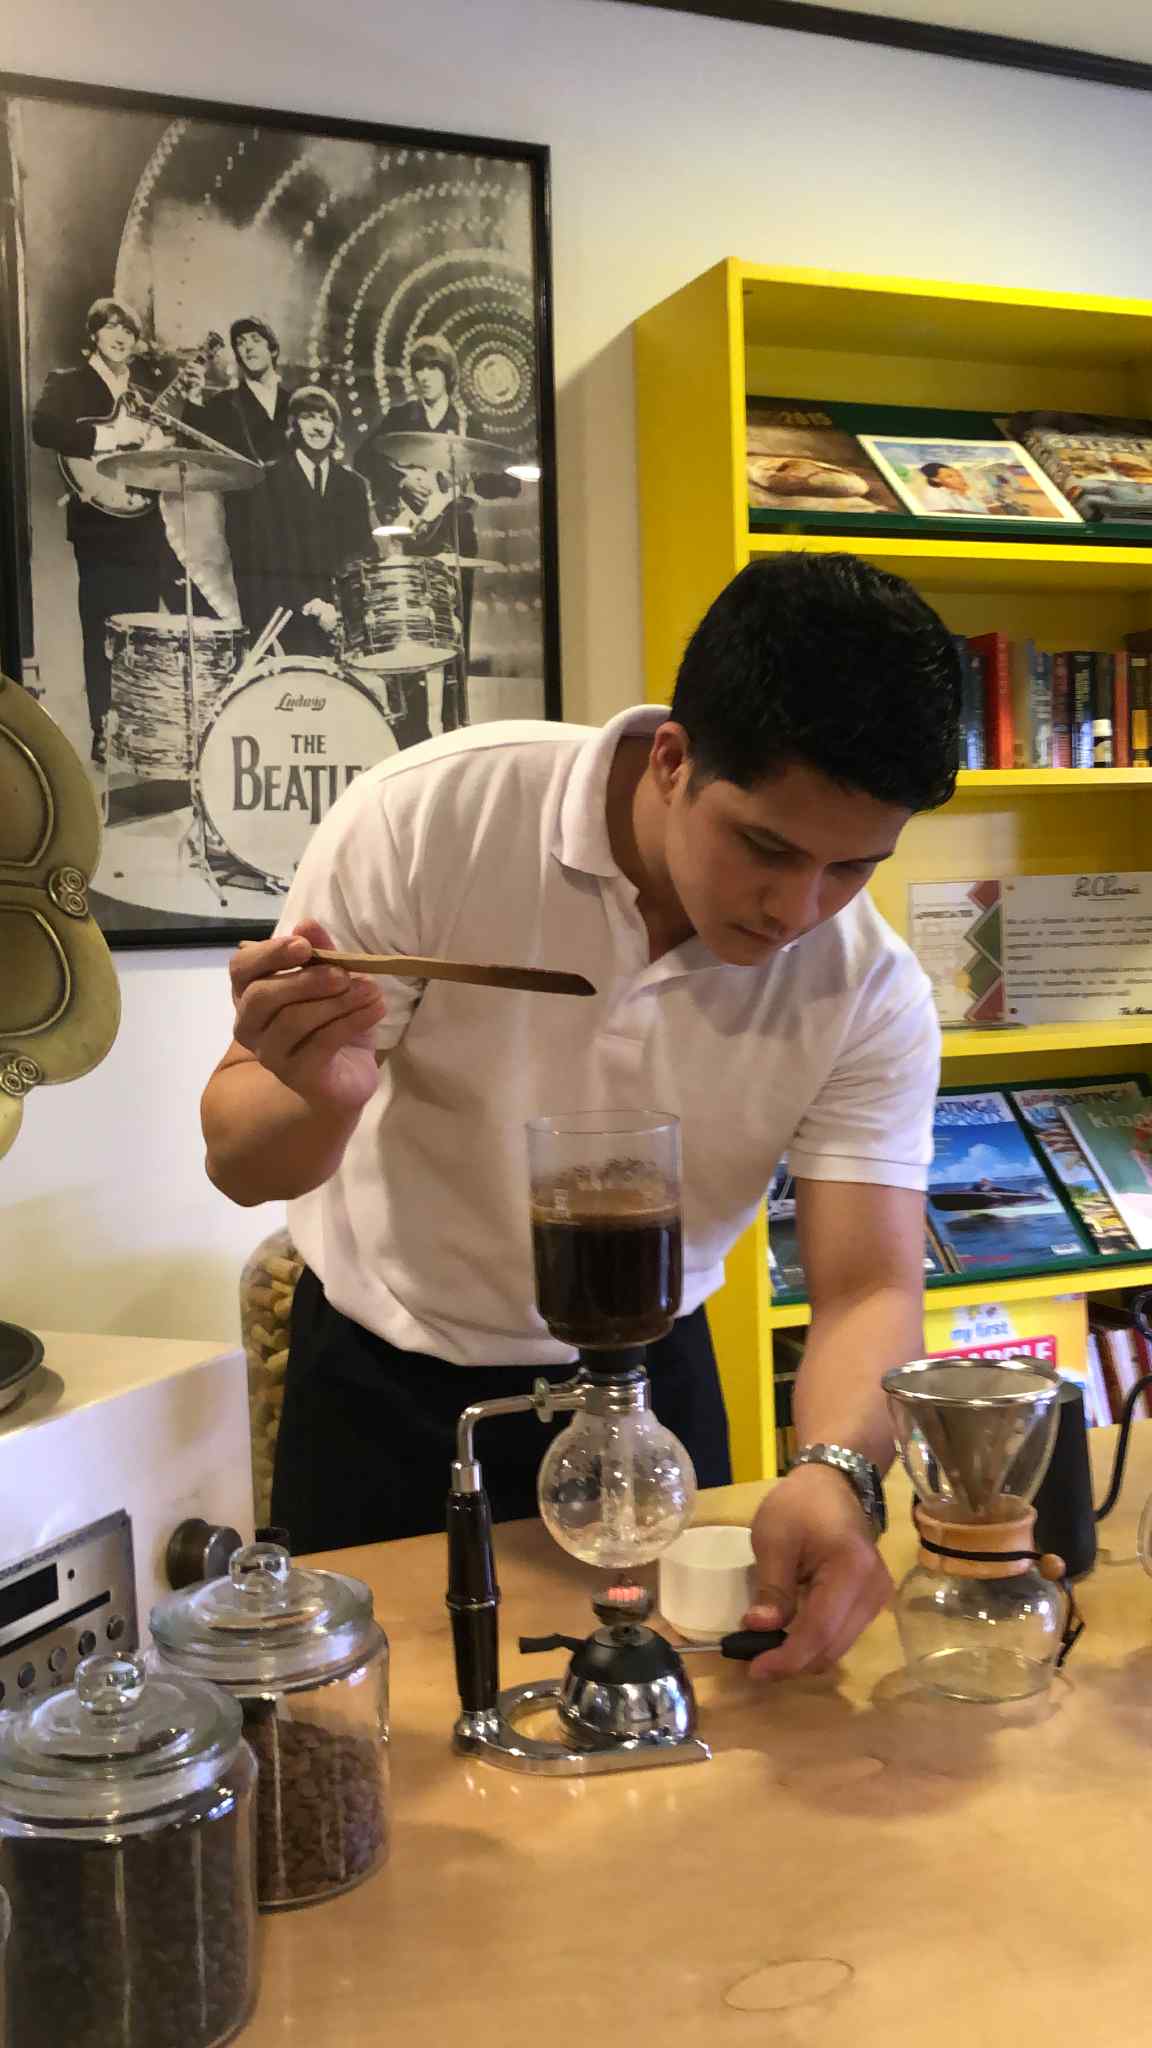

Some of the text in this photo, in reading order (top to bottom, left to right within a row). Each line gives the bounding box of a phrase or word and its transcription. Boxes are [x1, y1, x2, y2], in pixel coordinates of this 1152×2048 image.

[274, 692, 327, 711] Ludwig
[291, 734, 326, 754] THE
[232, 735, 372, 825] BEATL
[950, 1320, 1008, 1343] my first
